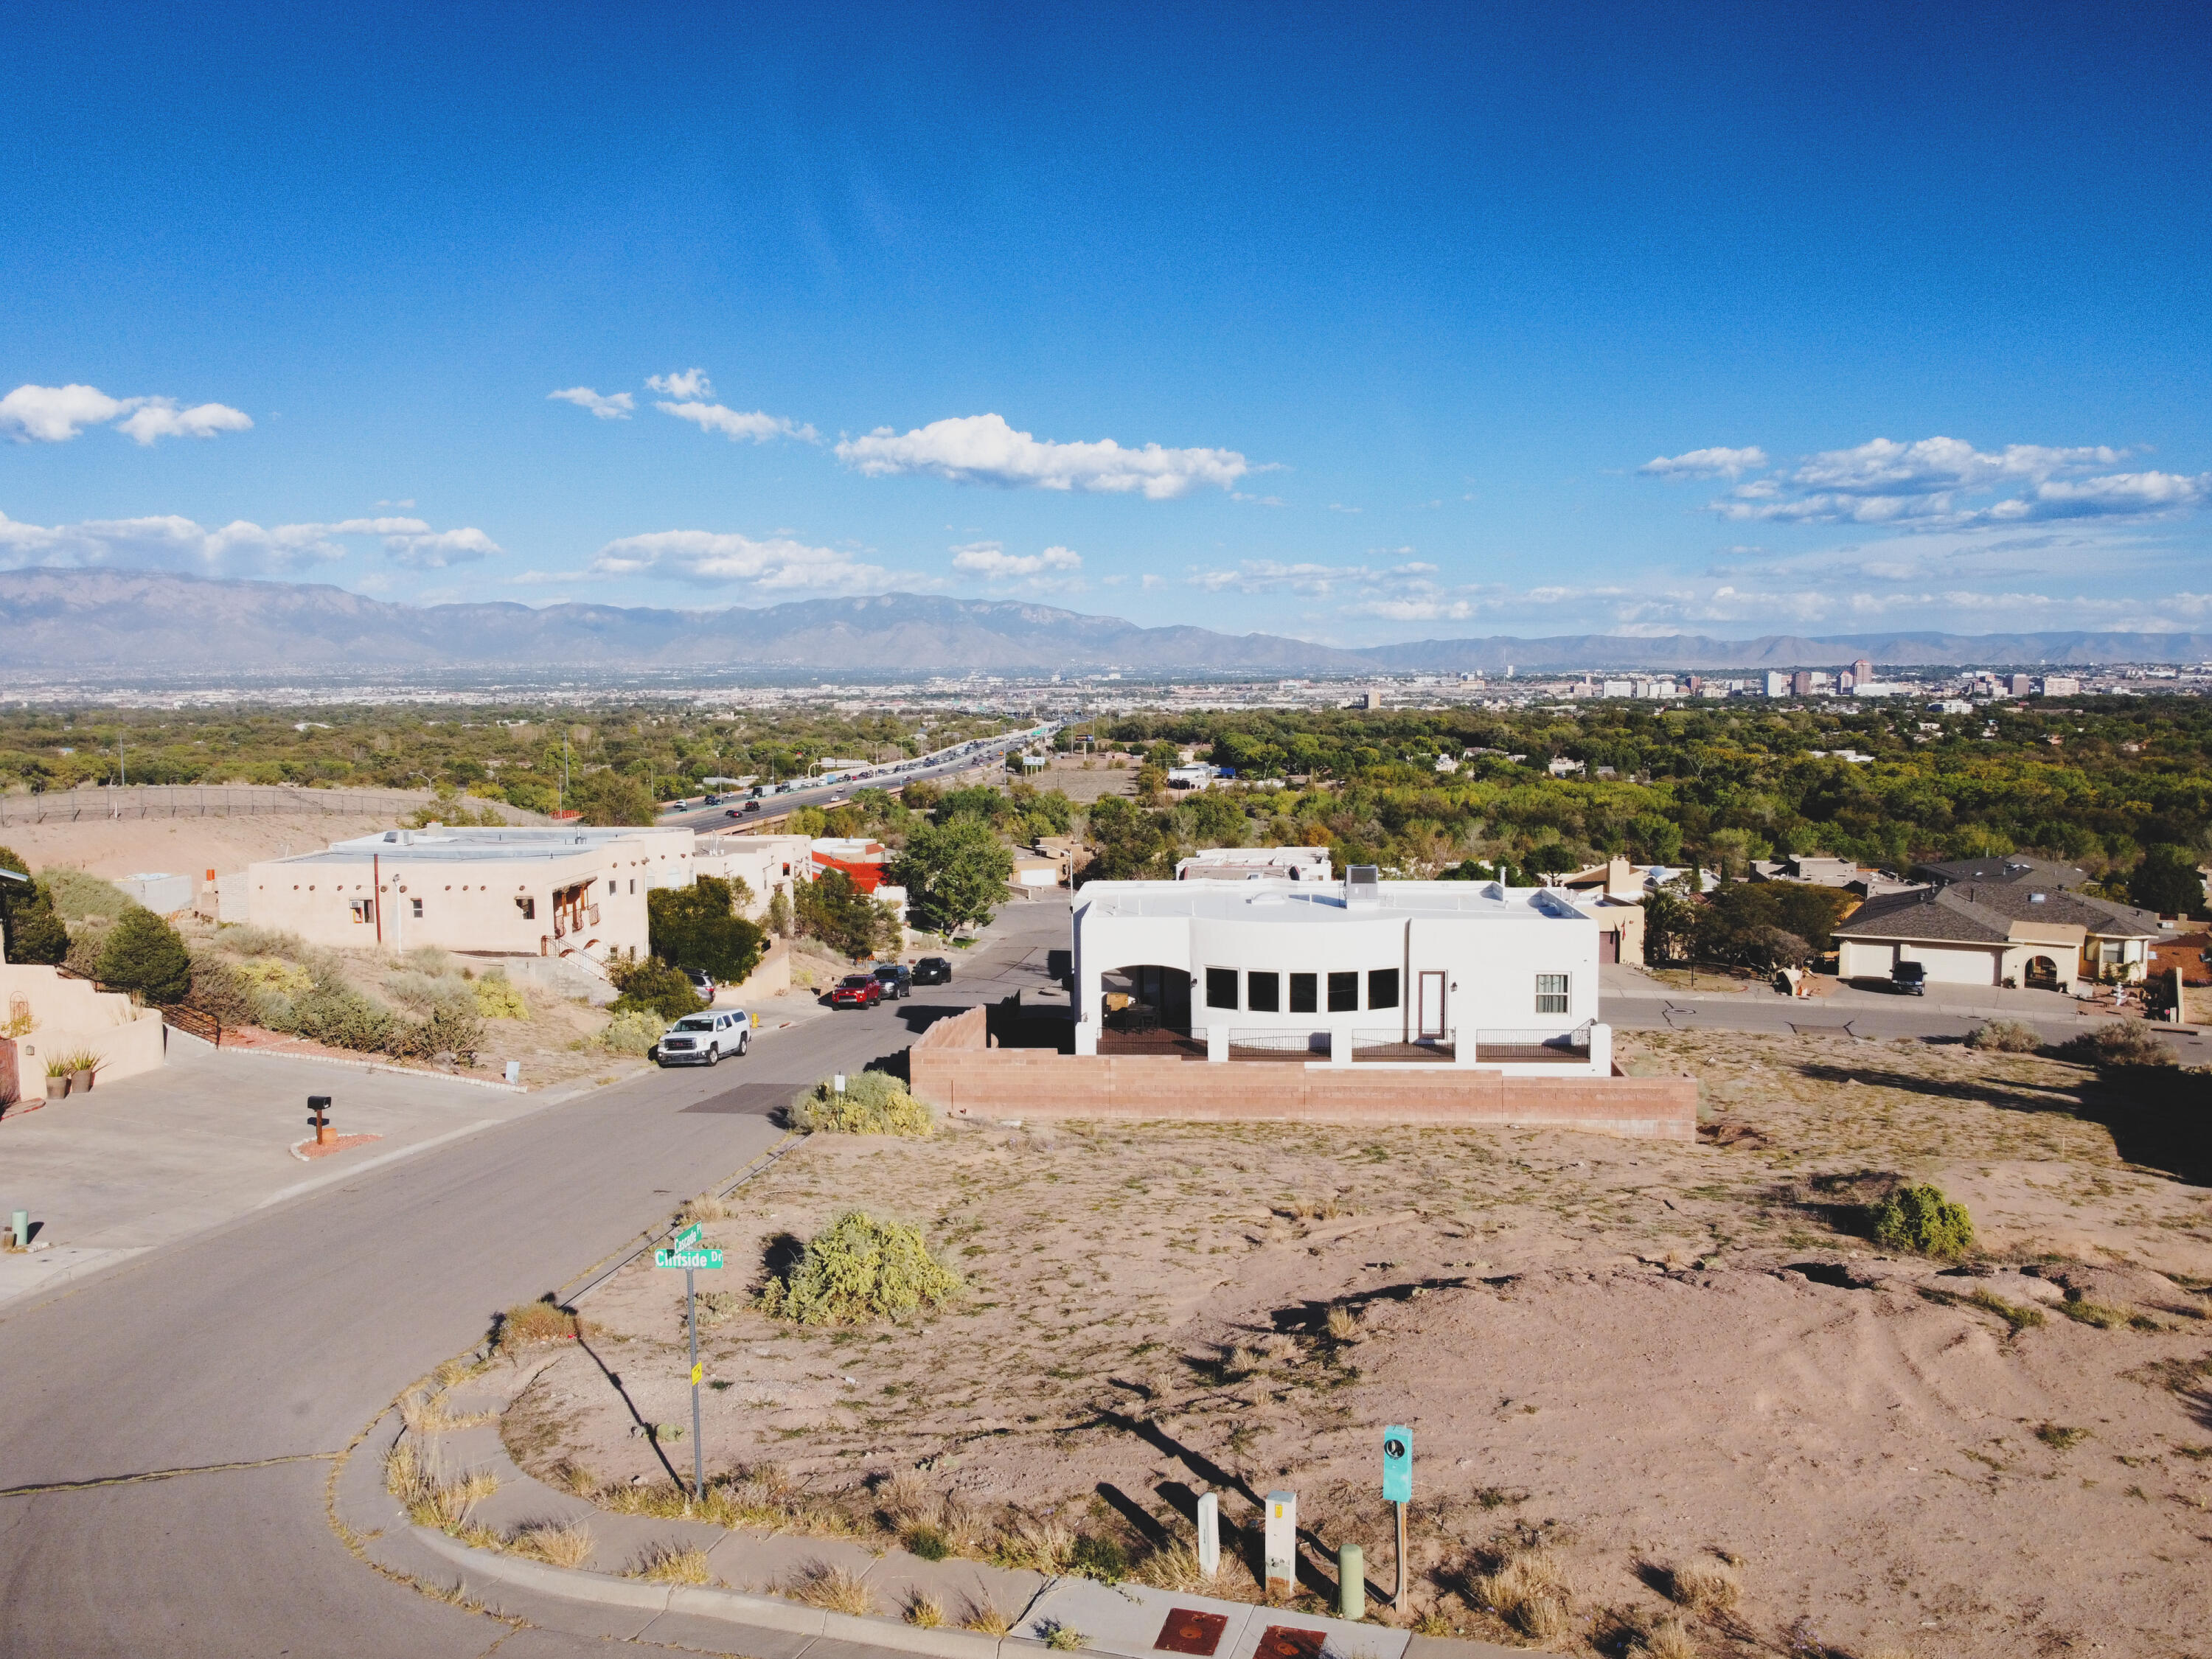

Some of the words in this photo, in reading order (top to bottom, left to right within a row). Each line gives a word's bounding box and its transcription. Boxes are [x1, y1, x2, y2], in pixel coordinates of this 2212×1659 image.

[675, 1229, 697, 1254] Cascade
[655, 1251, 708, 1267] Cliffside
[711, 1251, 723, 1262] Dr
